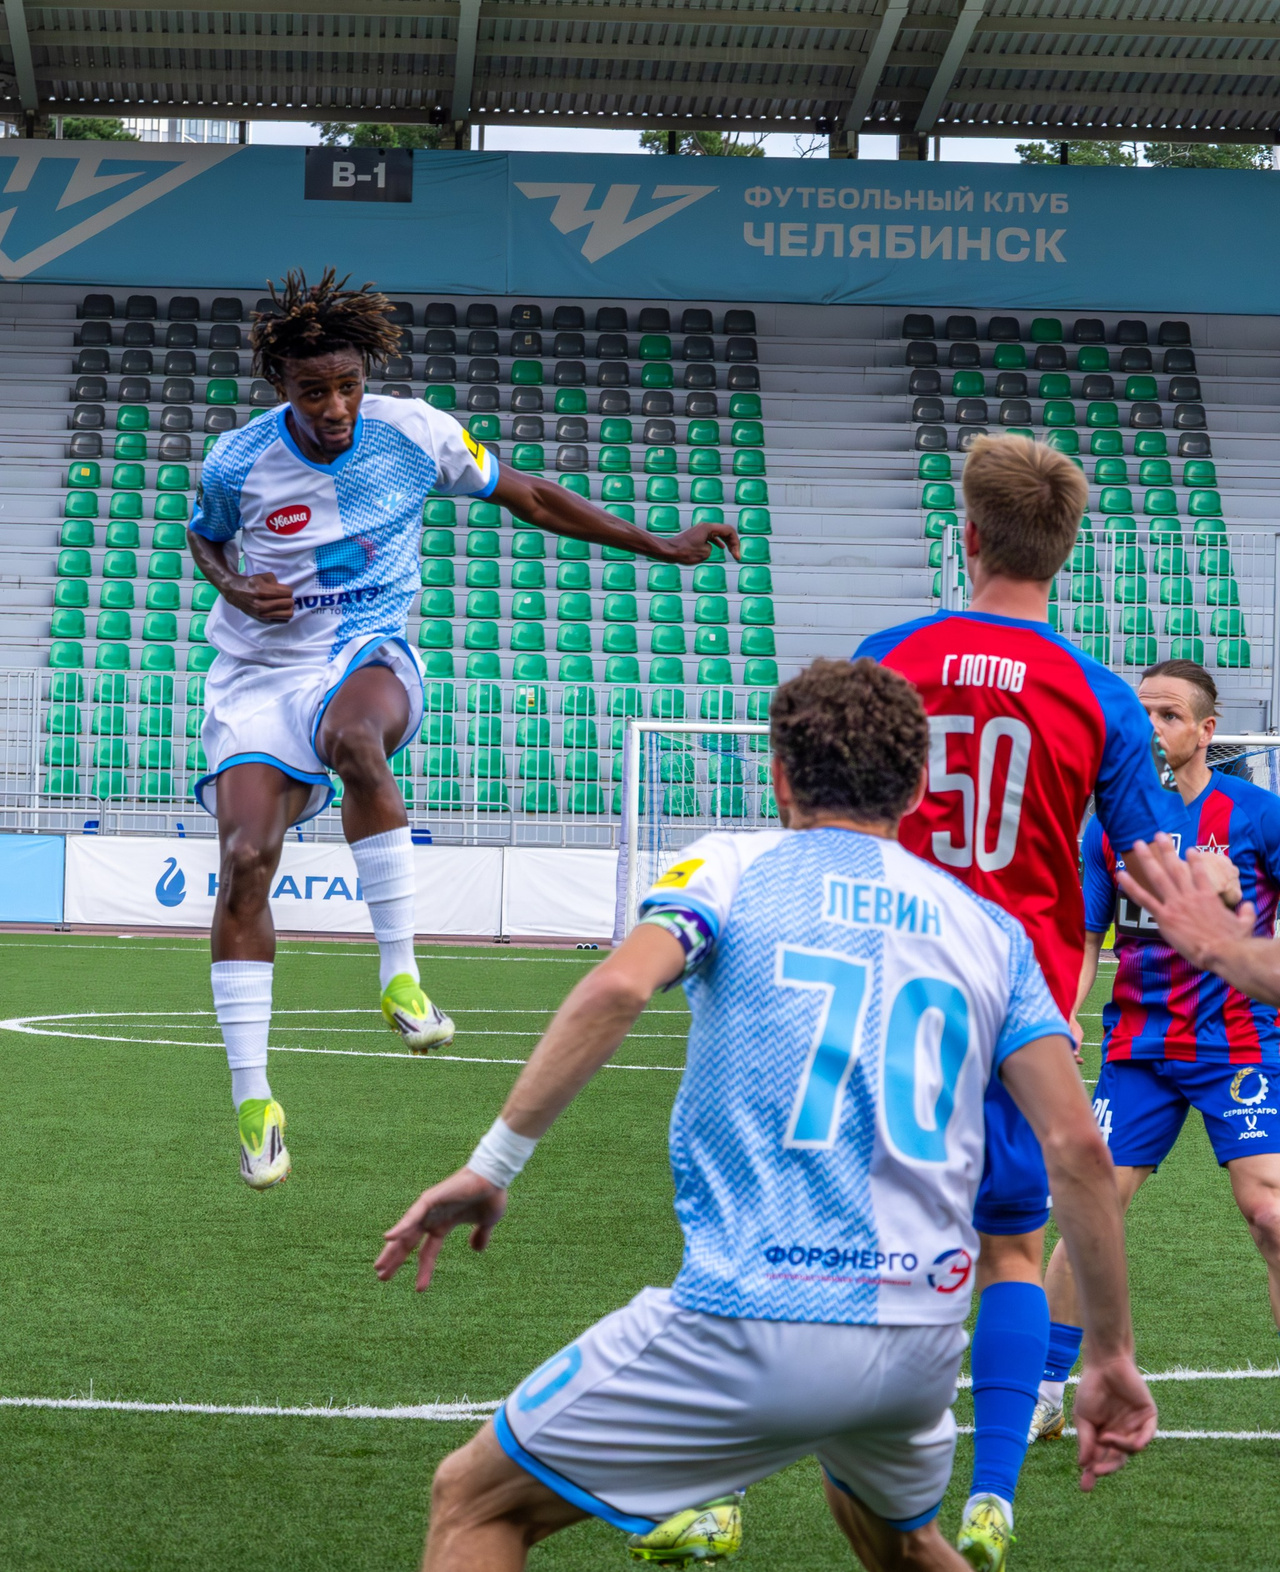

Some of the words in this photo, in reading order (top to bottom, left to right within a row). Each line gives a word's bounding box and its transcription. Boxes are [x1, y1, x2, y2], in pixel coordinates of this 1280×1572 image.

[744, 186, 974, 212] ФУТБОЛЬНЫЙ
[984, 191, 1069, 214] КЛУБ
[743, 222, 1067, 262] ЧЕЛЯБИНСК
[927, 714, 1032, 873] 50
[826, 878, 943, 937] ЛЕВИН
[777, 944, 972, 1166] 70
[1223, 1107, 1278, 1118] СЕРВИС-АГРО
[765, 1245, 918, 1272] ФОРЭНЕРГО
